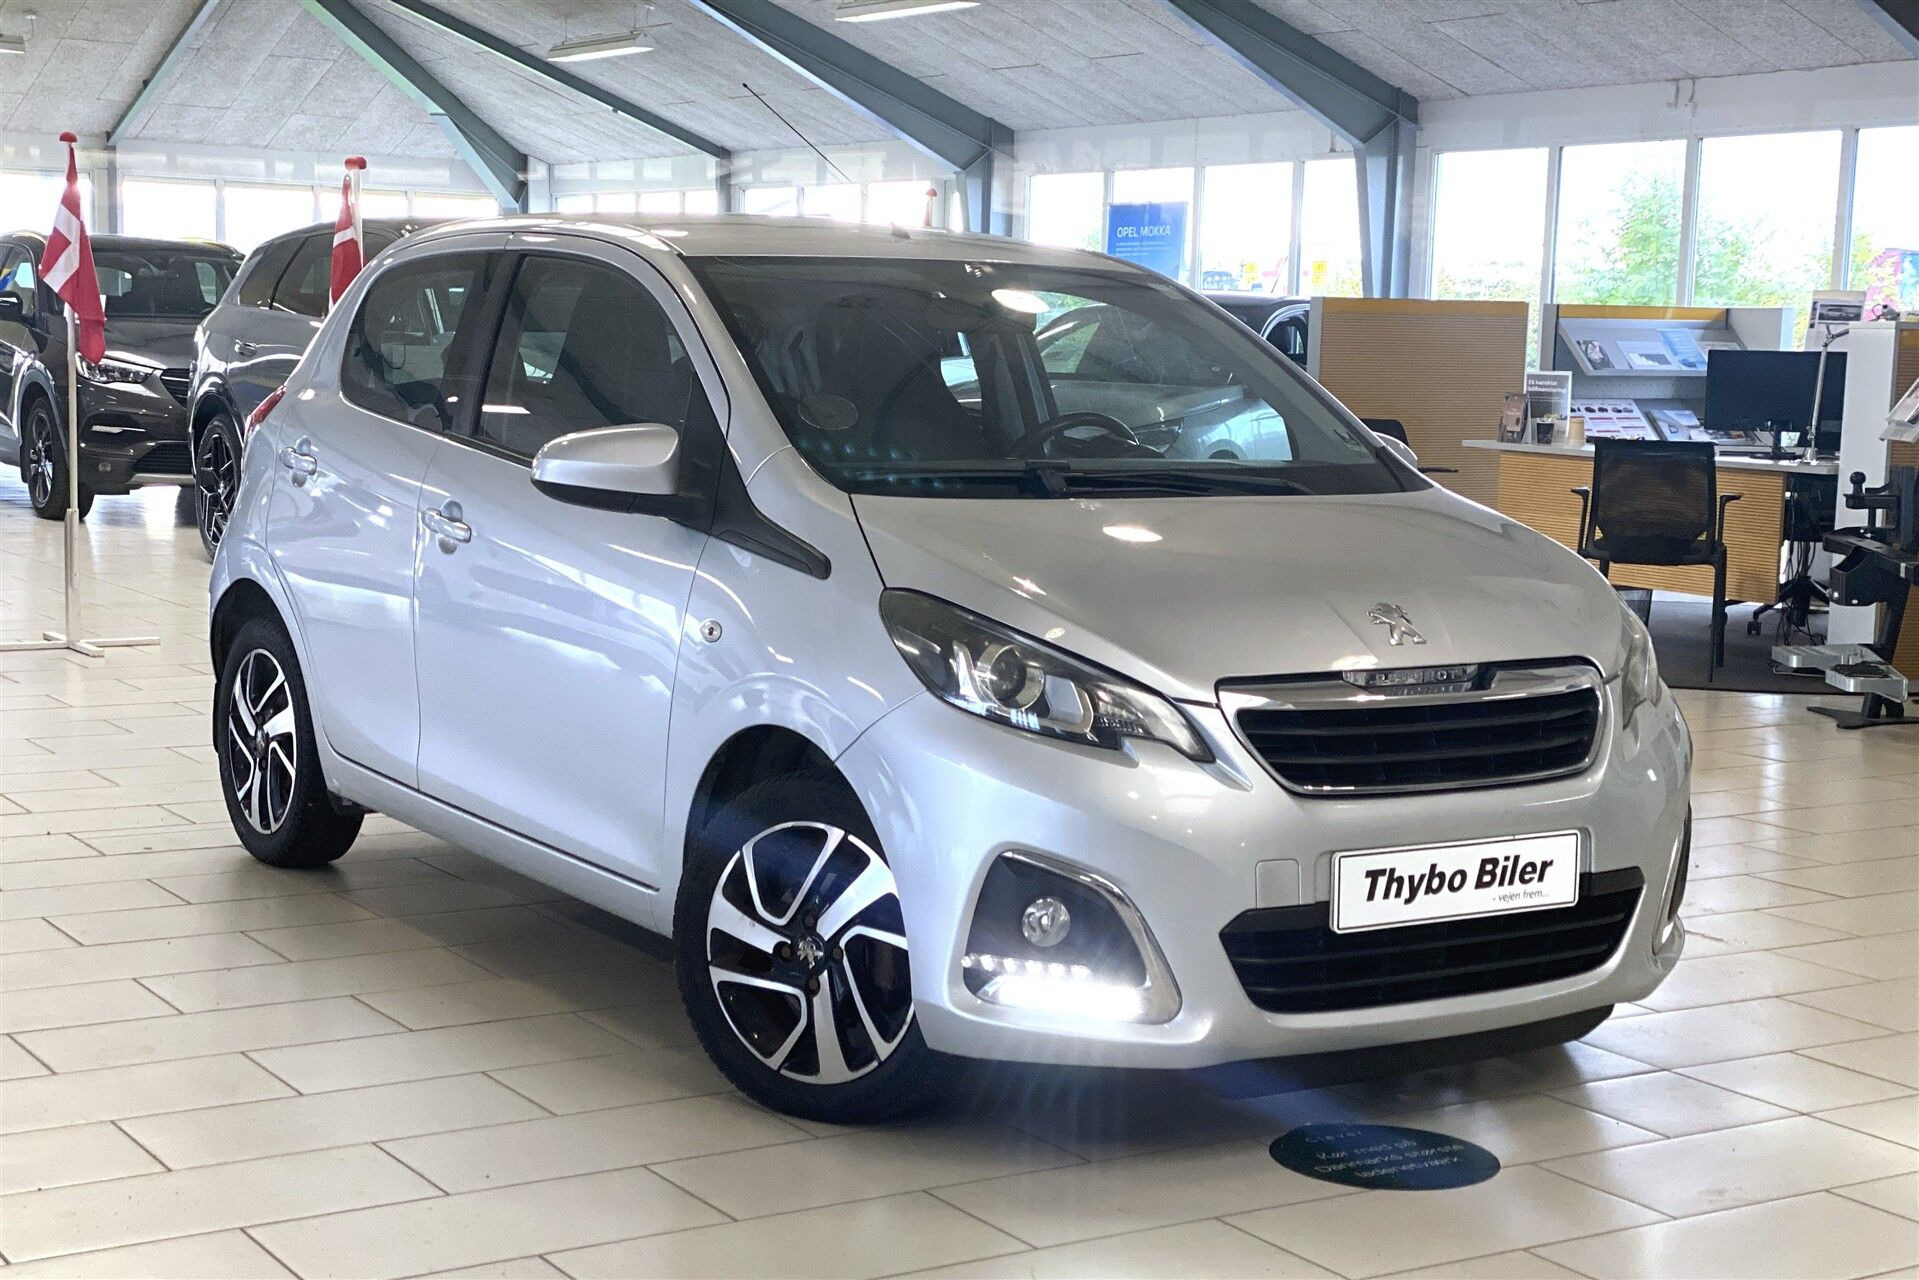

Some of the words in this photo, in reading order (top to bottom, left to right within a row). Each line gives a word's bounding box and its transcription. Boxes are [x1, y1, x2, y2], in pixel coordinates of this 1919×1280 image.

[1117, 226, 1138, 238] OPEL
[1140, 225, 1170, 237] MOKKA
[1364, 863, 1467, 905] Thybo
[1474, 854, 1554, 890] Biler
[1498, 891, 1520, 903] vejen
